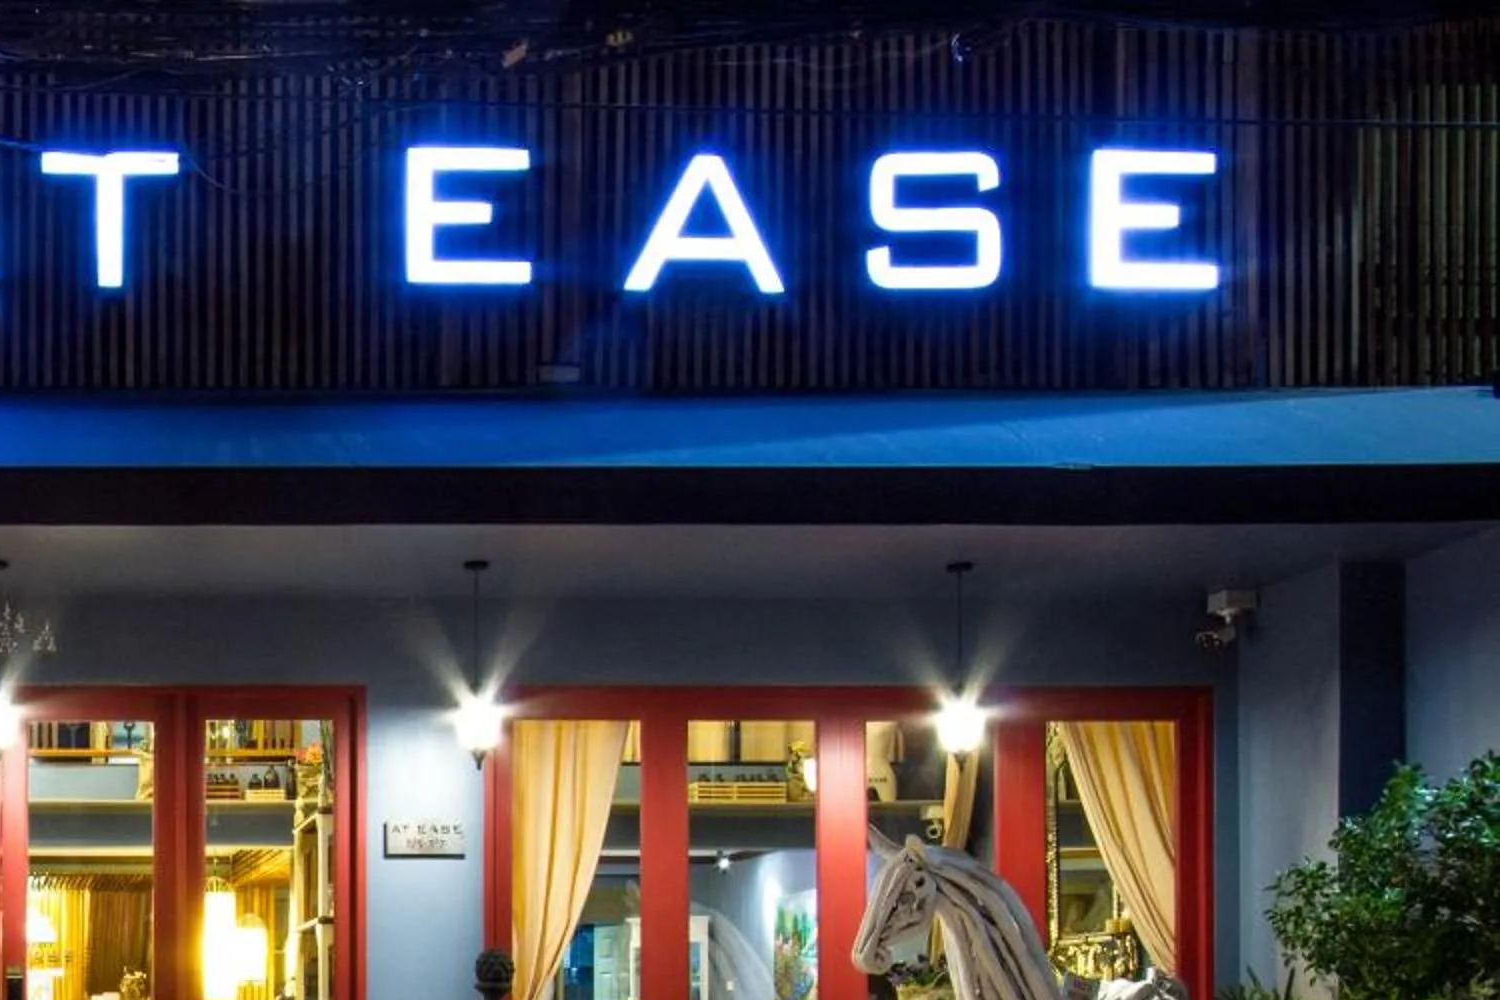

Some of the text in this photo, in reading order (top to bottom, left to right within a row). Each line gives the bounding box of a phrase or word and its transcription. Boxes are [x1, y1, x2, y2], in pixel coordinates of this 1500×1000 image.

[406, 147, 1219, 293] EASE
[391, 824, 463, 835] AT EASE
